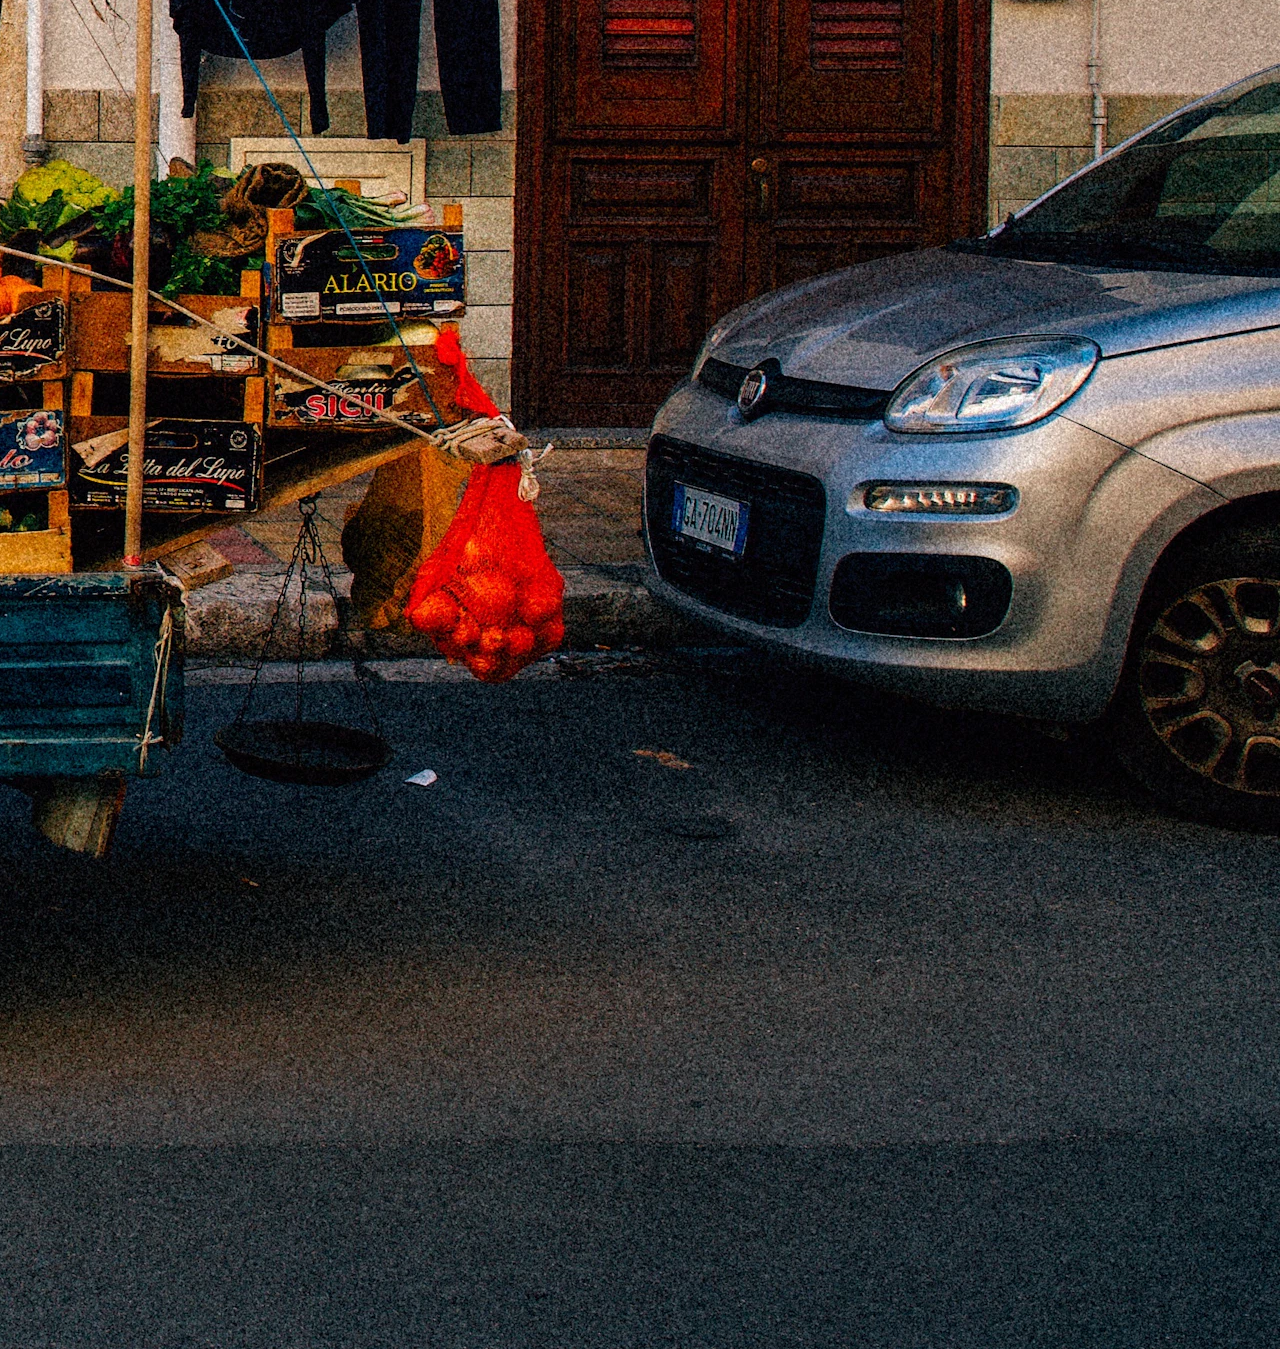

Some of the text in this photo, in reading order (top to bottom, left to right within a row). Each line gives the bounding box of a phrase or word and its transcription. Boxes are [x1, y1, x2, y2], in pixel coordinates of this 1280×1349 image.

[322, 271, 419, 294] ALARIO
[2, 328, 53, 356] Lupo
[165, 457, 203, 478] del
[195, 456, 246, 485] Lupo
[683, 496, 698, 530] GA
[700, 501, 739, 543] 704NN
